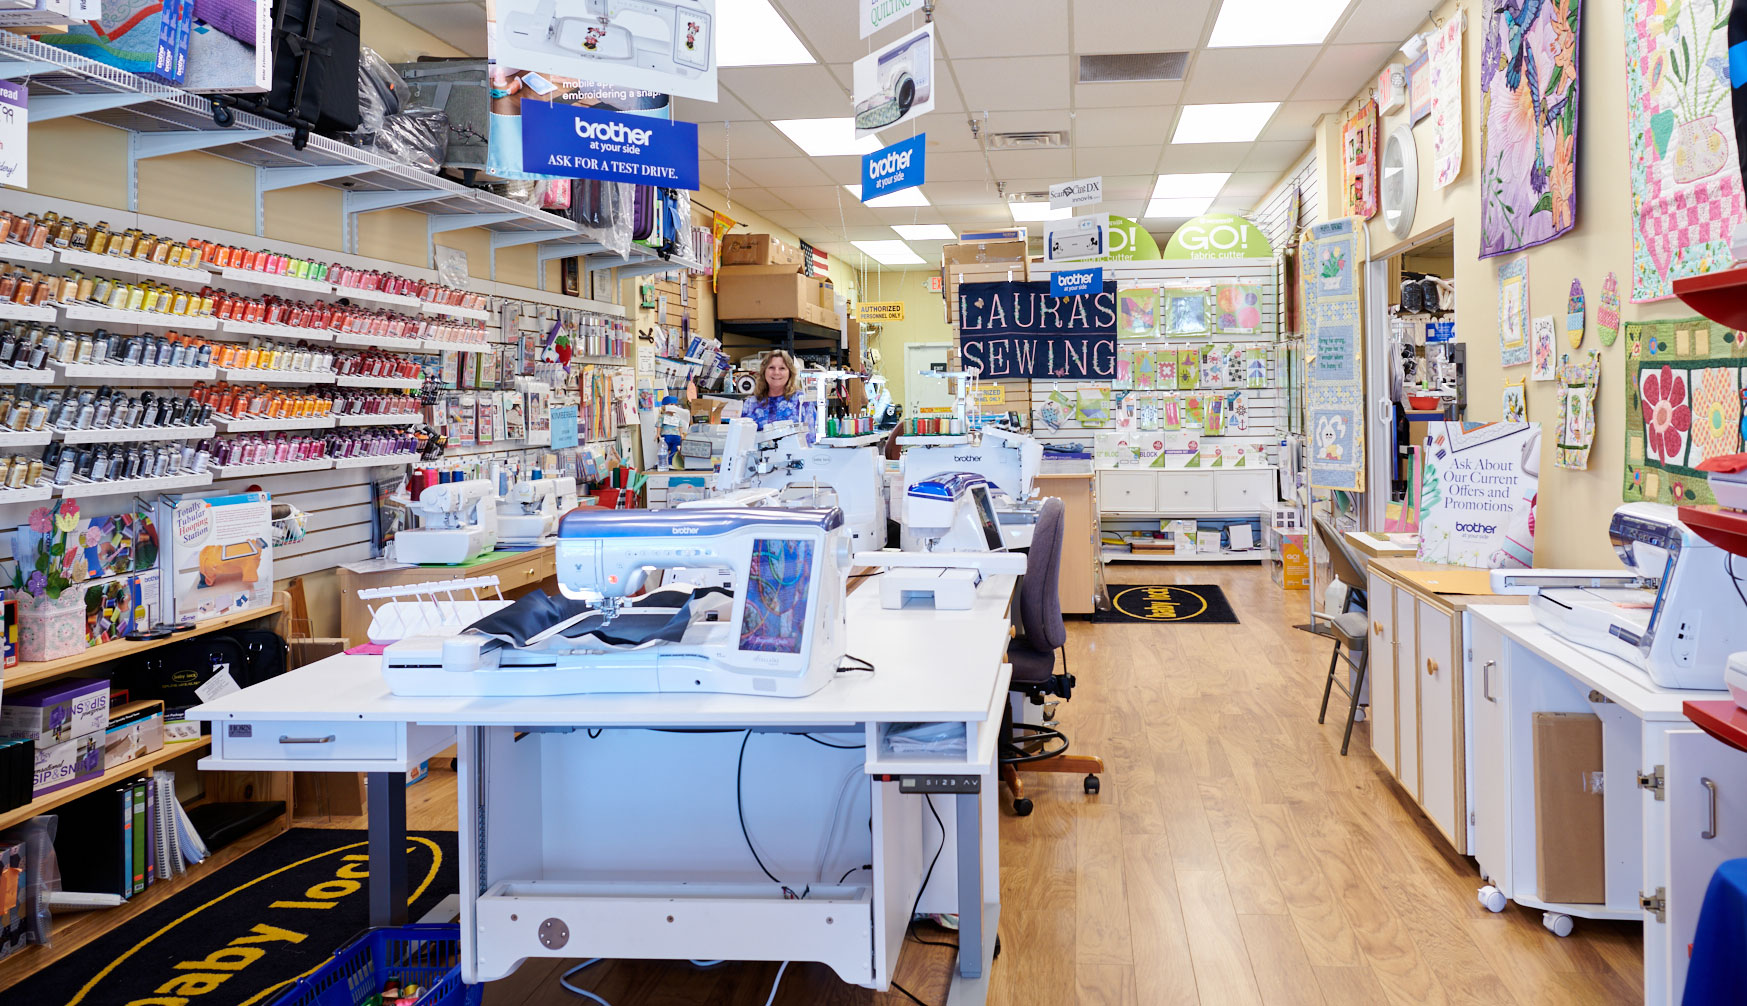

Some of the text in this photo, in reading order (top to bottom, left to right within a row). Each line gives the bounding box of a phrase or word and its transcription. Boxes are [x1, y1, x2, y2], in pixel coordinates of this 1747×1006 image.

[156, 45, 164, 69] brother
[164, 49, 172, 73] brother
[176, 53, 184, 76] brother
[0, 88, 18, 100] read
[562, 89, 627, 101] embroidering
[574, 117, 652, 146] brother
[590, 141, 641, 155] at your side
[548, 154, 679, 180] ASK FOR A TEST DRIVE.
[869, 149, 913, 180] brother
[876, 171, 904, 190] at your side
[1109, 226, 1137, 252] O!
[1178, 225, 1248, 250] GO!
[1107, 253, 1134, 262] cutter
[1190, 251, 1245, 261] fabric cutter
[931, 277, 942, 290] EX
[1057, 273, 1094, 287] brother
[860, 305, 901, 313] AUTHORIZED
[959, 291, 1116, 330] LAURA'S
[962, 339, 1116, 377] SEWING
[1449, 458, 1513, 471] Ask About
[1443, 470, 1519, 485] Our Current
[1449, 483, 1510, 498] Offers and
[176, 502, 201, 518] Totally
[1444, 496, 1514, 512] Promotions
[177, 509, 206, 527] Tubular
[179, 517, 208, 537] Hooping
[183, 526, 208, 544] Station
[672, 526, 699, 535] brother
[1455, 521, 1497, 534] brother
[268, 847, 416, 909] loc
